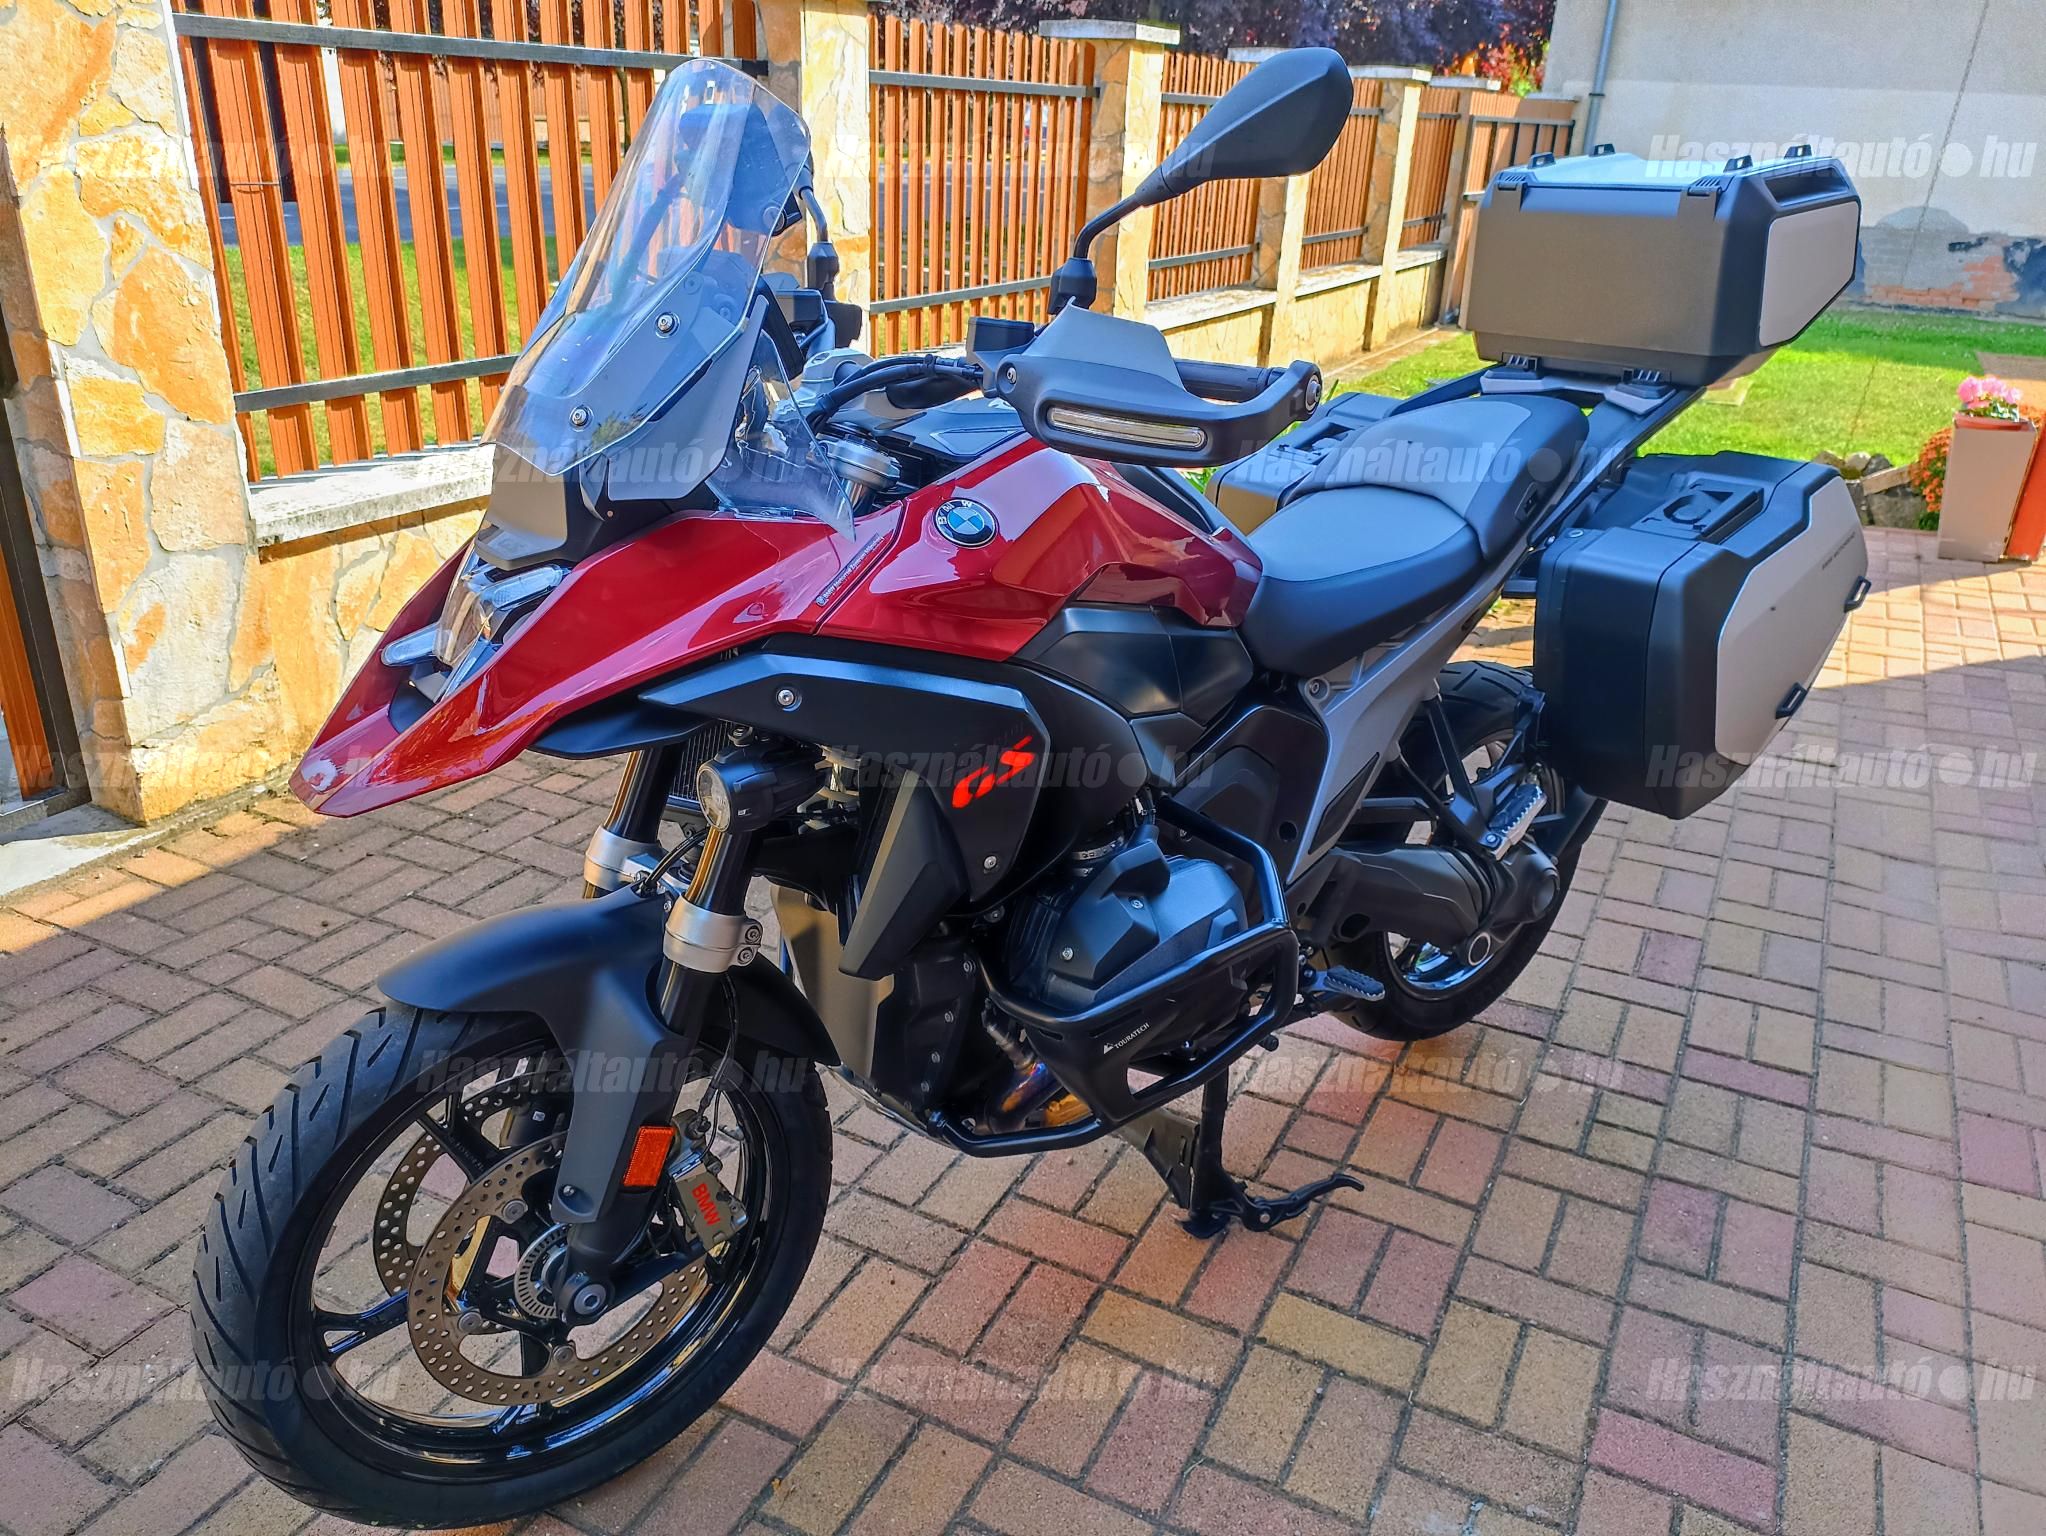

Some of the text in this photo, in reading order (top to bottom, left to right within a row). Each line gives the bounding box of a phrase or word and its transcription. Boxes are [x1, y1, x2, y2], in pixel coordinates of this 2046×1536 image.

[937, 500, 973, 525] BMW
[1114, 1022, 1150, 1049] TOURATECH
[692, 1183, 721, 1226] BMW
